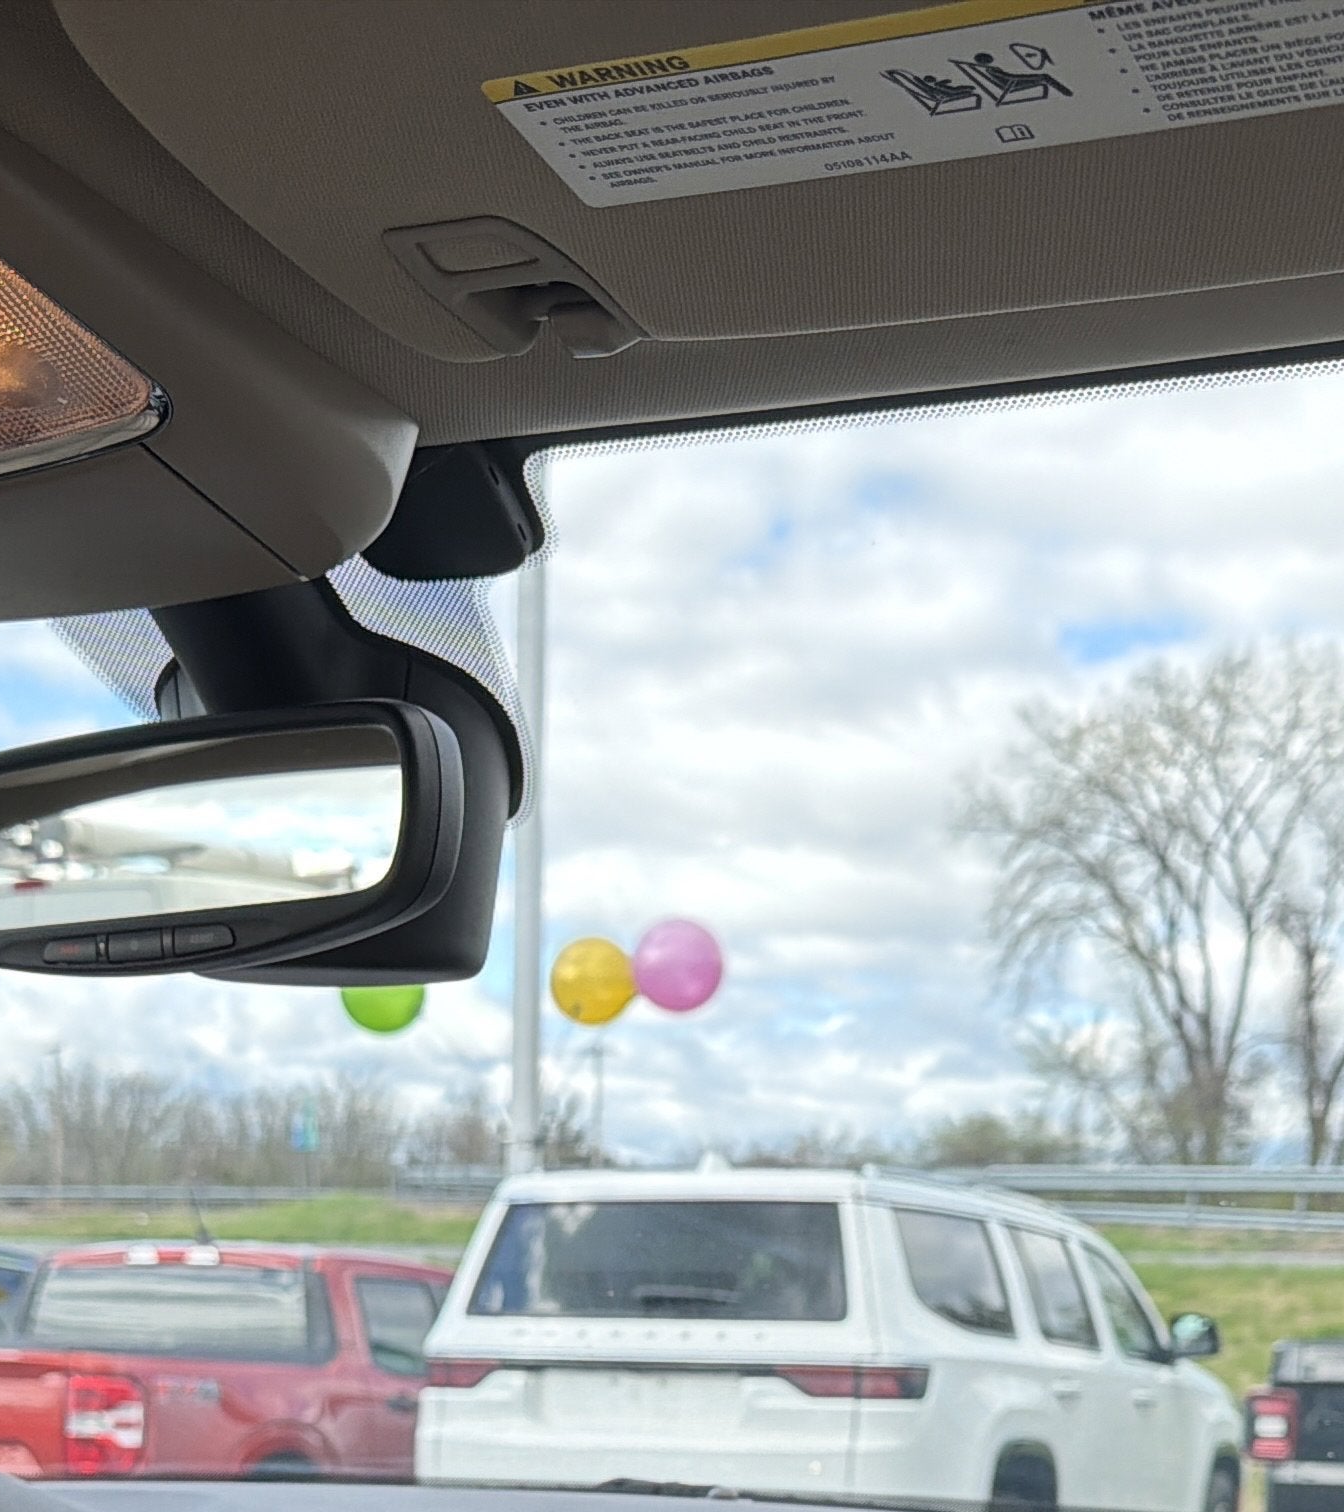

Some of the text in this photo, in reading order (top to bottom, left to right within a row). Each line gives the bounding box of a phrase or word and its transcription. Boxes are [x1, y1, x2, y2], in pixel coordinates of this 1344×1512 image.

[524, 67, 774, 111] EVEN WITH ADVANCED AIRBAGS
[547, 56, 690, 88] WARNING
[553, 112, 607, 125] CHILDREN
[609, 108, 632, 116] CAN
[650, 99, 688, 110] KILLED
[691, 96, 705, 105] OR
[708, 87, 768, 102] SERIOUSLY
[771, 79, 818, 92] INJURED
[822, 76, 835, 84] BY
[560, 125, 582, 133] THE
[570, 136, 593, 145] THE
[594, 132, 624, 142] BACK
[624, 128, 652, 138] SEAT
[664, 123, 688, 132] THE
[688, 117, 729, 129] SAFEST
[730, 112, 765, 123] PLACE
[767, 108, 790, 117] FOR
[581, 146, 616, 158] NEVER
[619, 143, 640, 151] PUT
[723, 127, 756, 137] CHILD
[758, 122, 785, 132] SEAT
[803, 117, 826, 125] THE
[593, 158, 634, 169] ALWAYS
[635, 154, 656, 162] USE
[717, 143, 740, 151] AND
[742, 138, 776, 147] CHILD
[601, 170, 623, 179] SEE
[672, 159, 720, 171] MANUAL
[720, 155, 745, 164] FOR
[747, 150, 778, 161] MORE
[779, 139, 856, 156] INFORMATION
[857, 132, 895, 144] ABOUT
[824, 150, 912, 173] 05108114AA
